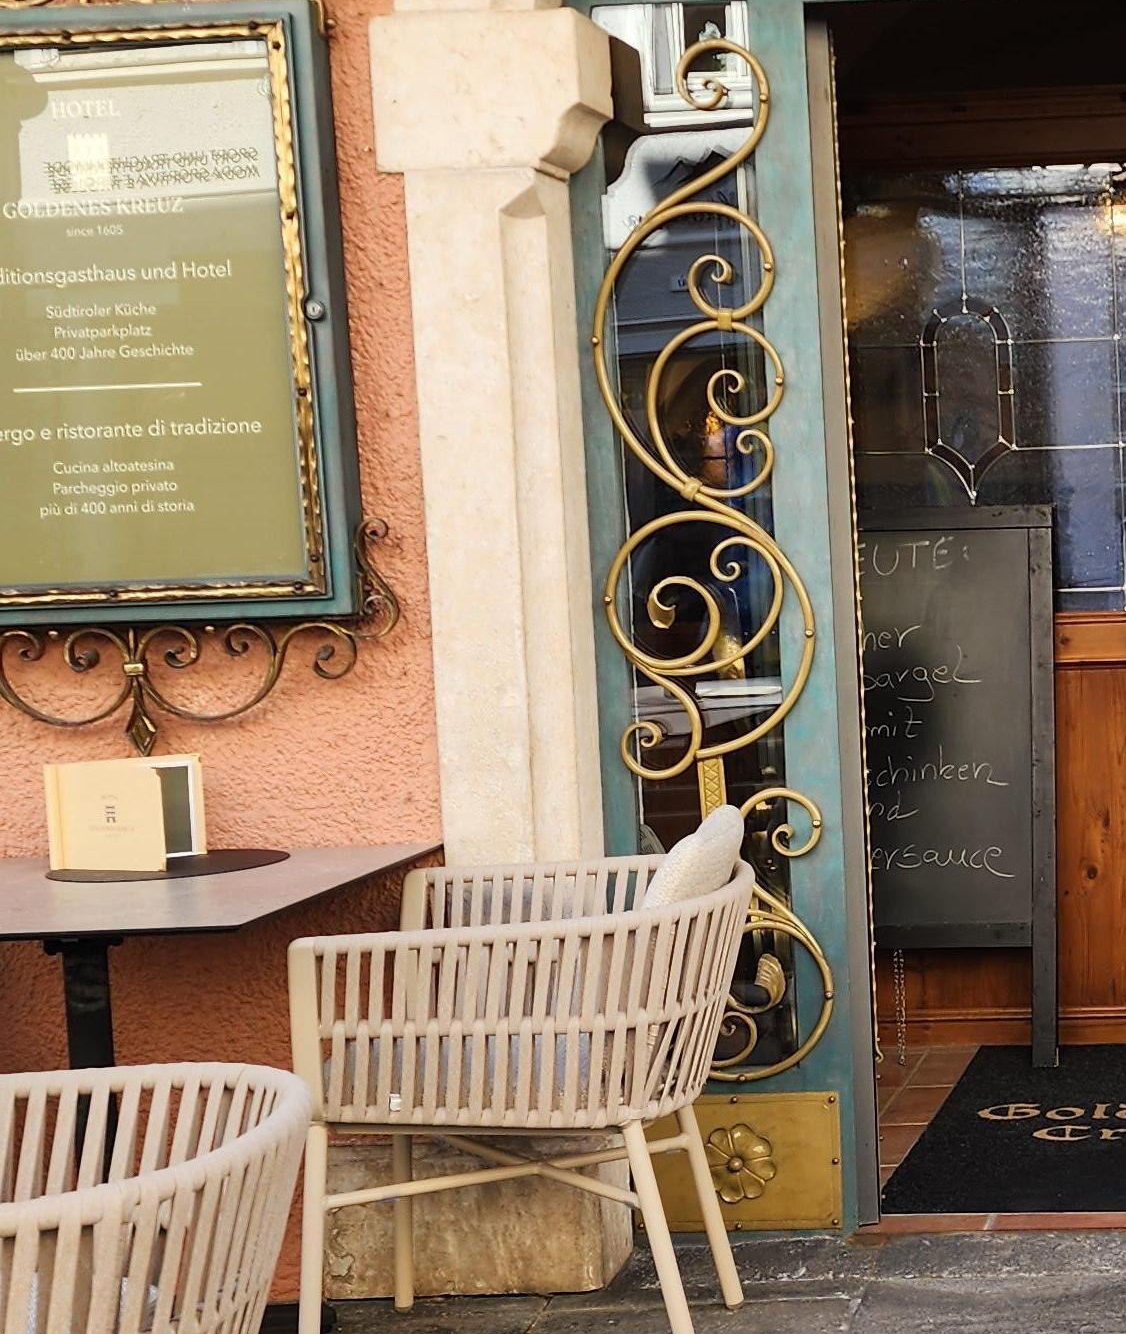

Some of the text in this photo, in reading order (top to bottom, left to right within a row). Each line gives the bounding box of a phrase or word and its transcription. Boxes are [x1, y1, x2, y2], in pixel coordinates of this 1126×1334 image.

[51, 98, 121, 118] HOTEL
[3, 197, 184, 219] GOLDENES KREUZ
[66, 223, 124, 236] since 1605
[141, 261, 177, 280] und
[182, 259, 232, 279] Hotel
[46, 302, 156, 319] Südtiroler Küche
[54, 323, 152, 340] Privatparkplatz
[16, 342, 194, 362] über 400 Jahre Geschichte
[40, 428, 51, 440] e
[57, 423, 143, 440] ristorante
[148, 419, 165, 436] di
[170, 417, 262, 435] tradizione
[53, 458, 175, 475] Cucina altoatesina
[53, 479, 177, 497] Parcheggio privato
[40, 499, 195, 518] più di 400 anni di storia
[865, 705, 923, 738] mit
